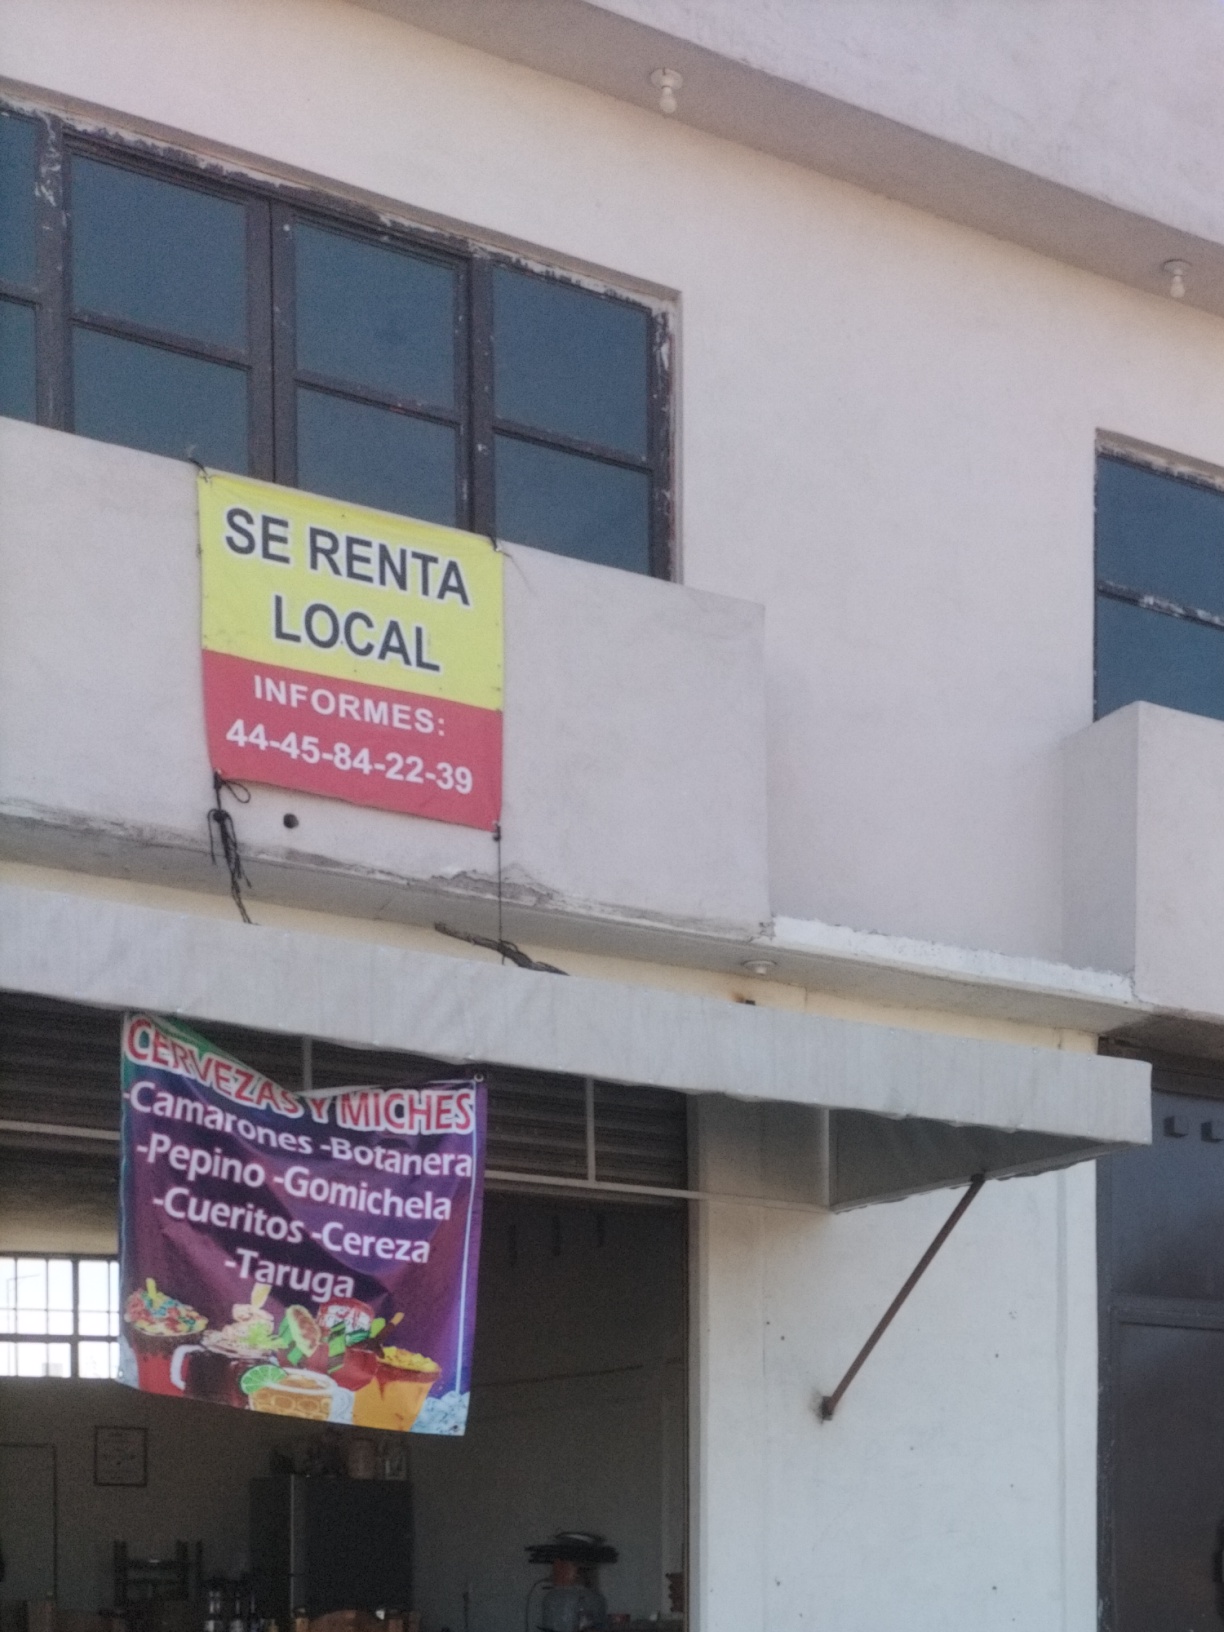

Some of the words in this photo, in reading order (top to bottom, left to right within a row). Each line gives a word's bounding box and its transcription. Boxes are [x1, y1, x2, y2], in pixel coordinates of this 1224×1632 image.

[225, 507, 291, 564] SE
[309, 526, 471, 606] RENTA
[273, 594, 441, 673] LOCAL
[253, 674, 446, 737] INFORMES:
[225, 718, 473, 795] 44-45-84-22-39
[126, 1016, 302, 1116] CERVEZAS
[308, 1096, 331, 1119] Y
[340, 1092, 473, 1131] MICHES
[123, 1081, 313, 1154] -Camarones
[320, 1137, 473, 1178] -Botanera
[136, 1133, 266, 1188] -Pepino
[273, 1165, 452, 1221] -Gomichela
[153, 1187, 304, 1244] -Cueritos
[311, 1221, 431, 1264] -Cereza
[224, 1248, 355, 1302] -Taruga
